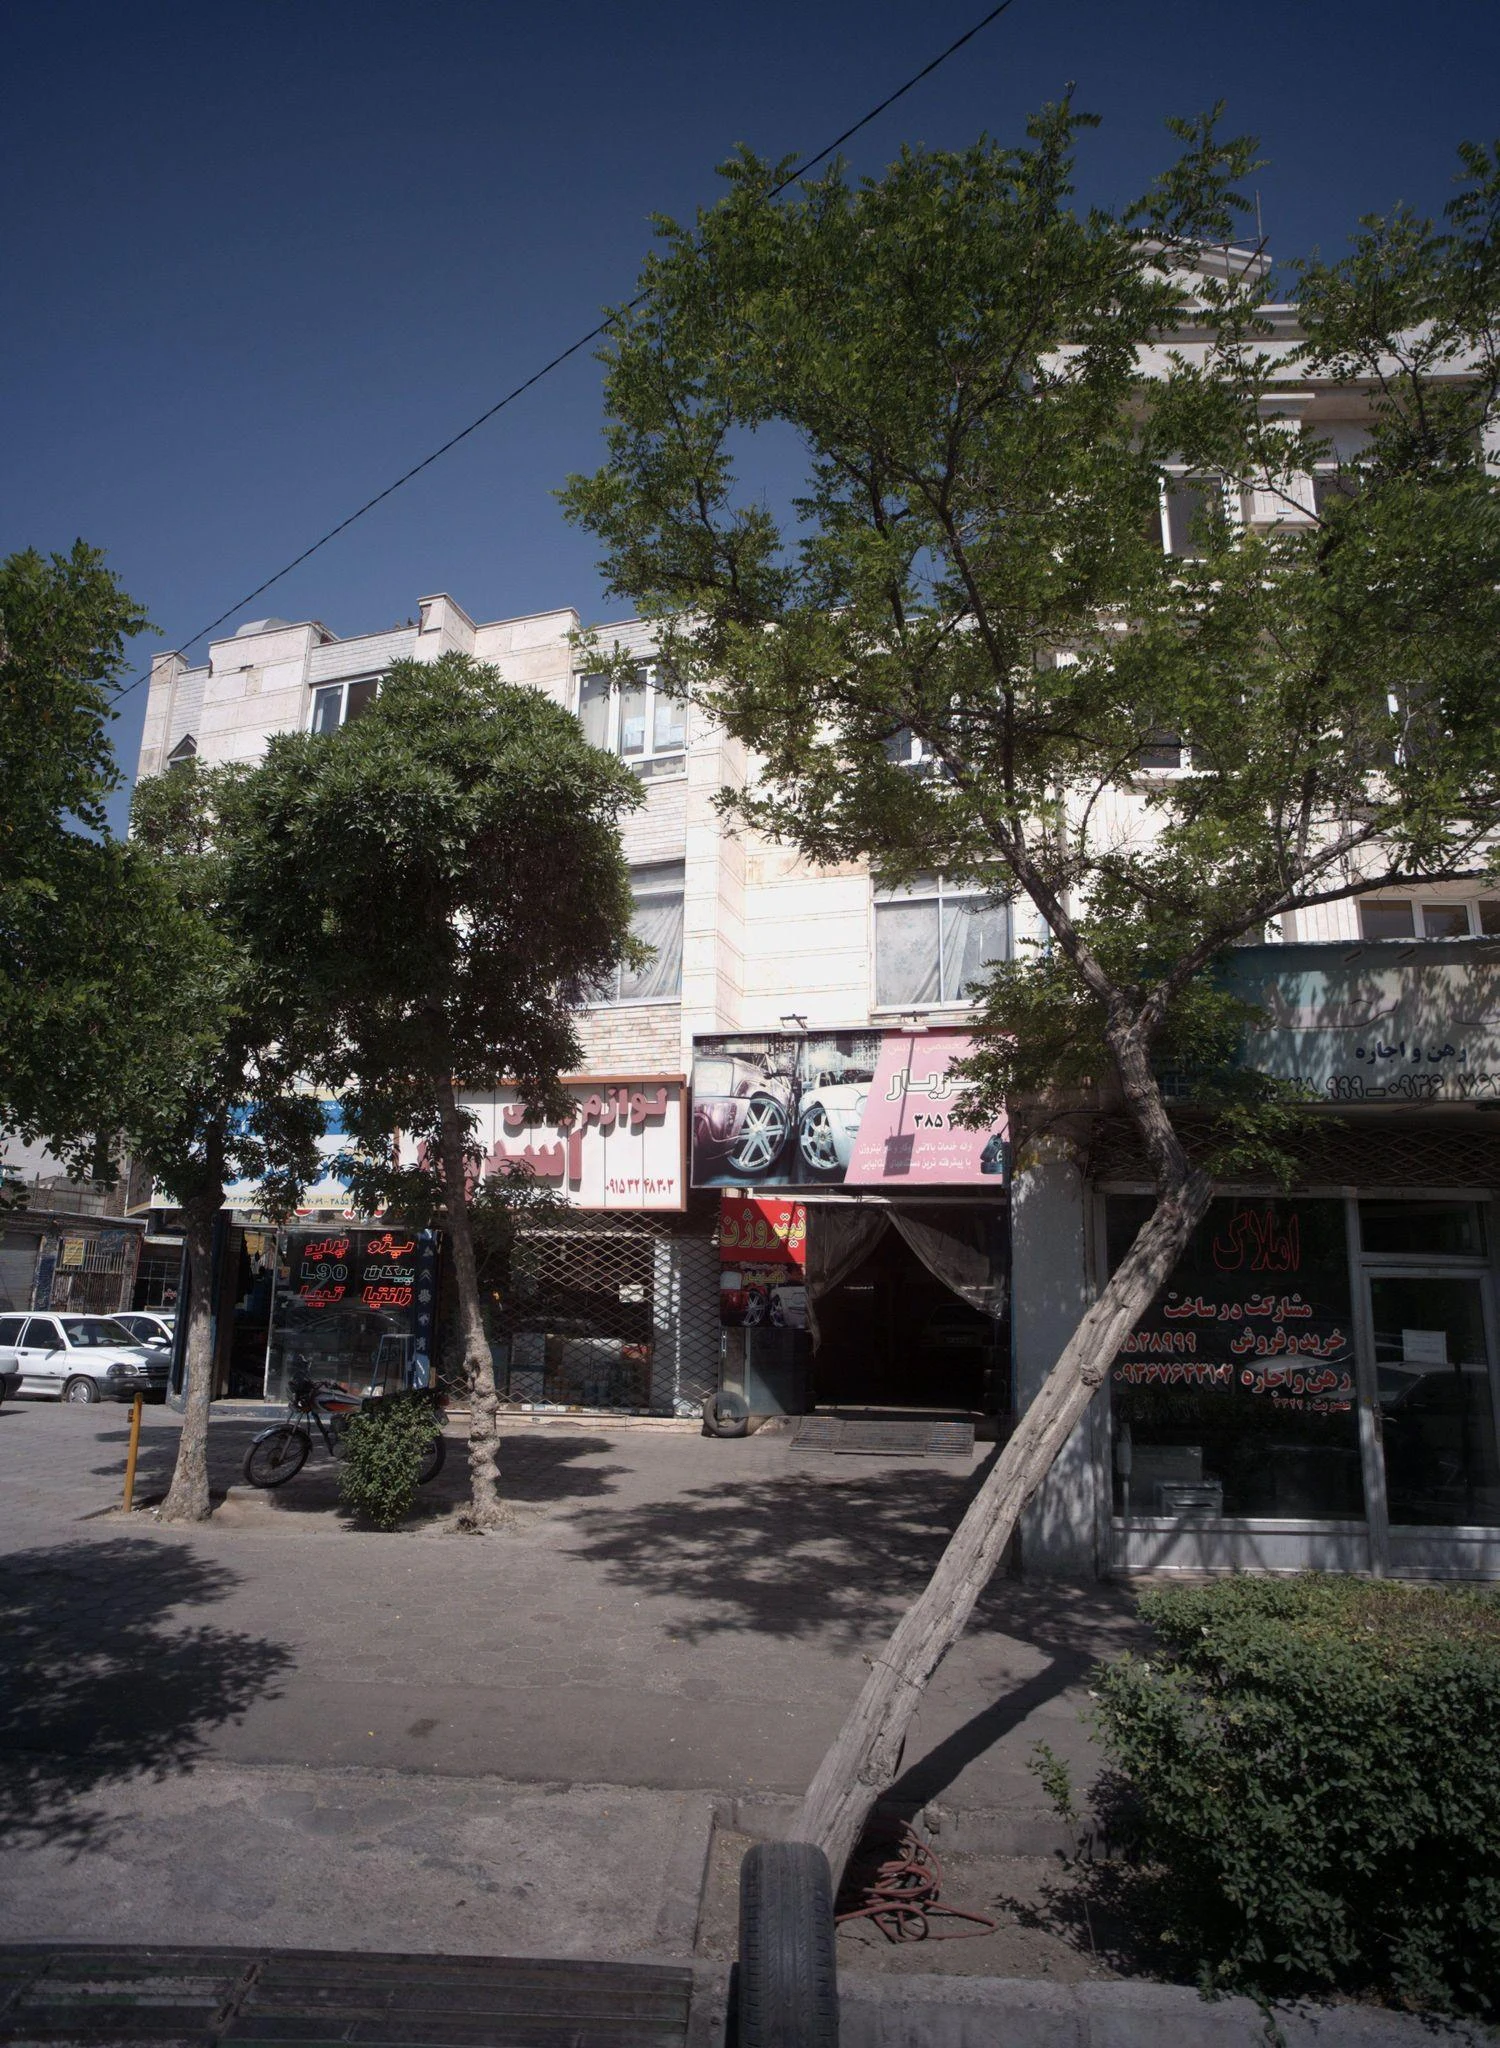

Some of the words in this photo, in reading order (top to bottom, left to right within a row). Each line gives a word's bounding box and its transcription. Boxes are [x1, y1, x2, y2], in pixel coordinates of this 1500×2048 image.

[1355, 1041, 1405, 1065] اجاره
[1411, 1049, 1422, 1063] و
[1426, 1042, 1467, 1063] رهن
[582, 1087, 668, 1126] لوازم
[720, 1208, 806, 1249] نیتروژن
[1213, 1210, 1300, 1271] املاک
[305, 1238, 349, 1260] پراید
[367, 1233, 414, 1259] پژو
[300, 1262, 348, 1281] L90
[363, 1265, 414, 1286] پیکان
[300, 1286, 345, 1308] تیبا
[362, 1286, 413, 1309] زانتیا
[1164, 1292, 1216, 1318] ساخت
[1245, 1293, 1312, 1322] مشارکت
[1218, 1302, 1243, 1320] در
[1230, 1326, 1286, 1355] فروش
[1284, 1334, 1297, 1354] و
[1299, 1328, 1347, 1356] خرید
[1241, 1368, 1292, 1398] اجاره
[1291, 1373, 1305, 1393] و
[1305, 1368, 1351, 1393] رهن
